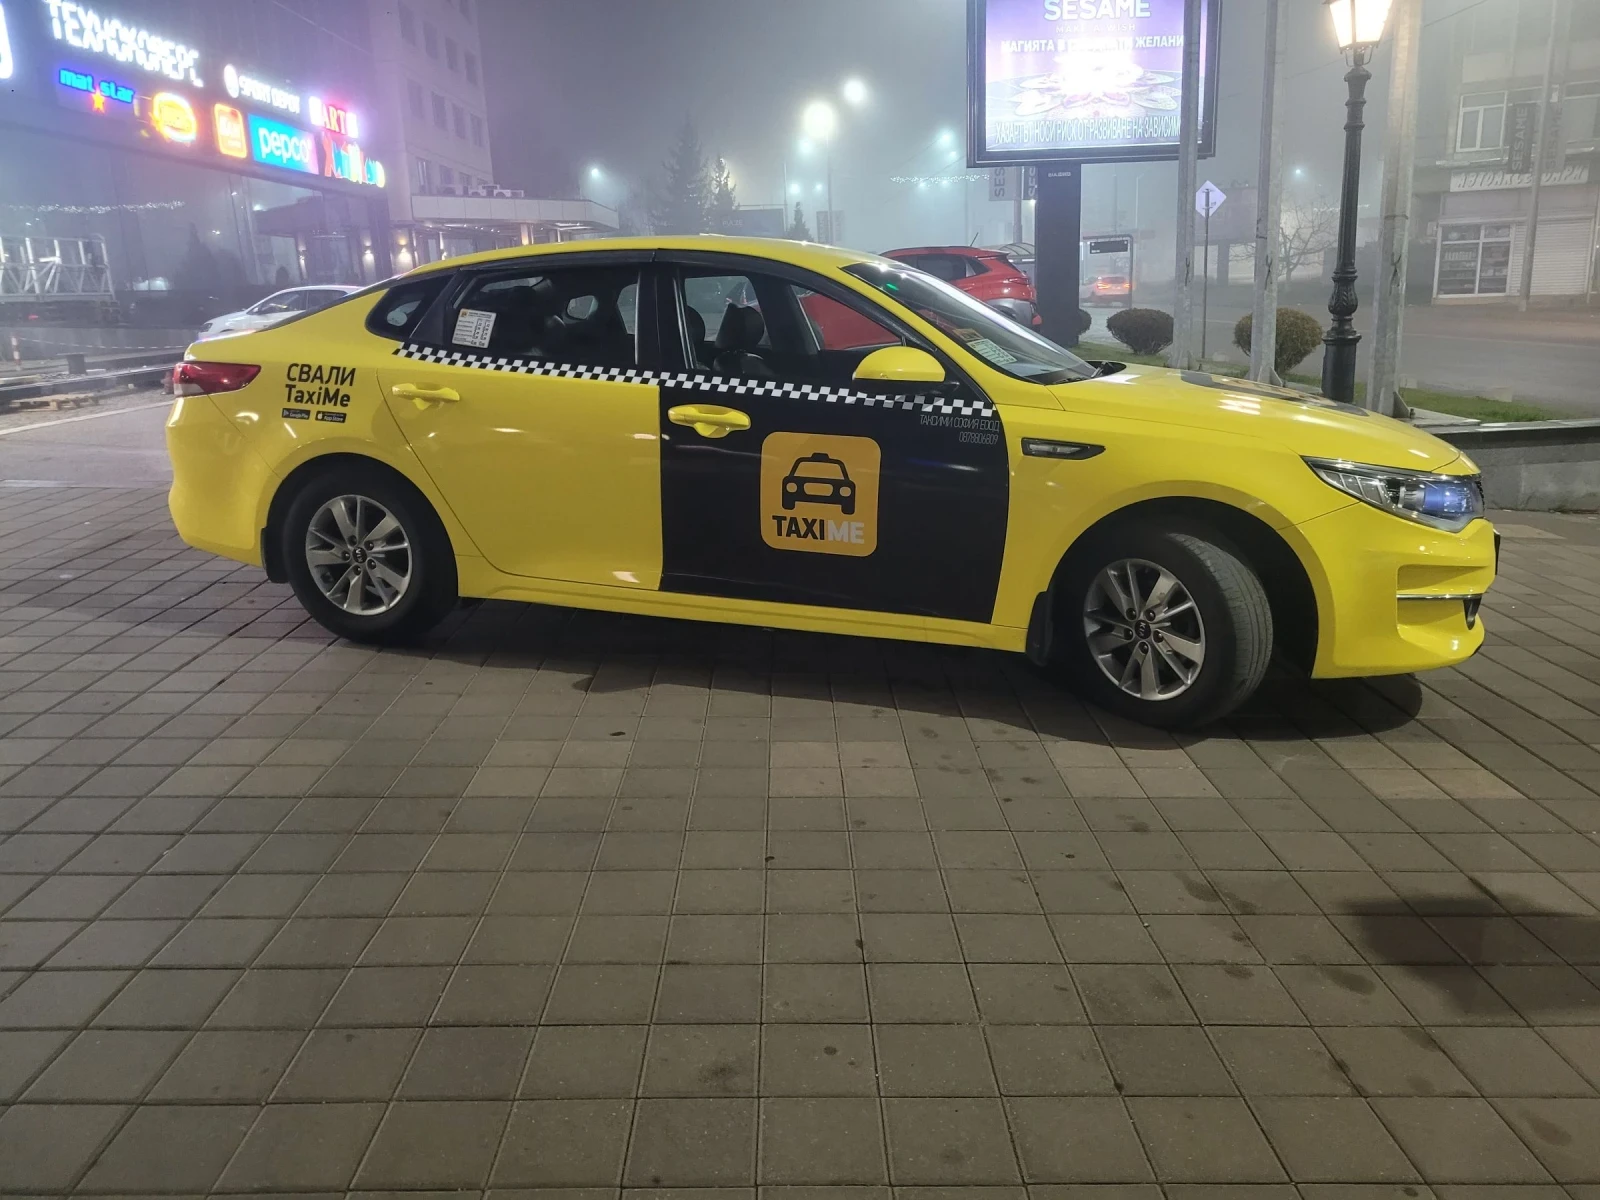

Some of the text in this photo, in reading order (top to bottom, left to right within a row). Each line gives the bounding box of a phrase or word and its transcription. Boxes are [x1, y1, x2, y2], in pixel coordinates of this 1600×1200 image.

[1044, 0, 1151, 20] SESAME
[1107, 23, 1136, 32] WISH
[1135, 35, 1184, 48] ЖЕЛАНИ
[1057, 120, 1077, 142] РИСК
[1078, 119, 1090, 141] ОТ
[1090, 117, 1131, 140] РАЗВИВАНЕ
[1132, 116, 1142, 138] НА
[1144, 115, 1180, 138] ЗАВИСИМ
[1512, 106, 1528, 171] SESAME
[258, 127, 311, 163] pepco
[1457, 164, 1585, 188] АВТОАКСЕОАРИ
[287, 363, 356, 386] СВАЛИ
[285, 384, 351, 407] TaxiMe
[954, 417, 979, 430] СОФИЯ
[772, 515, 865, 544] TAXIME
